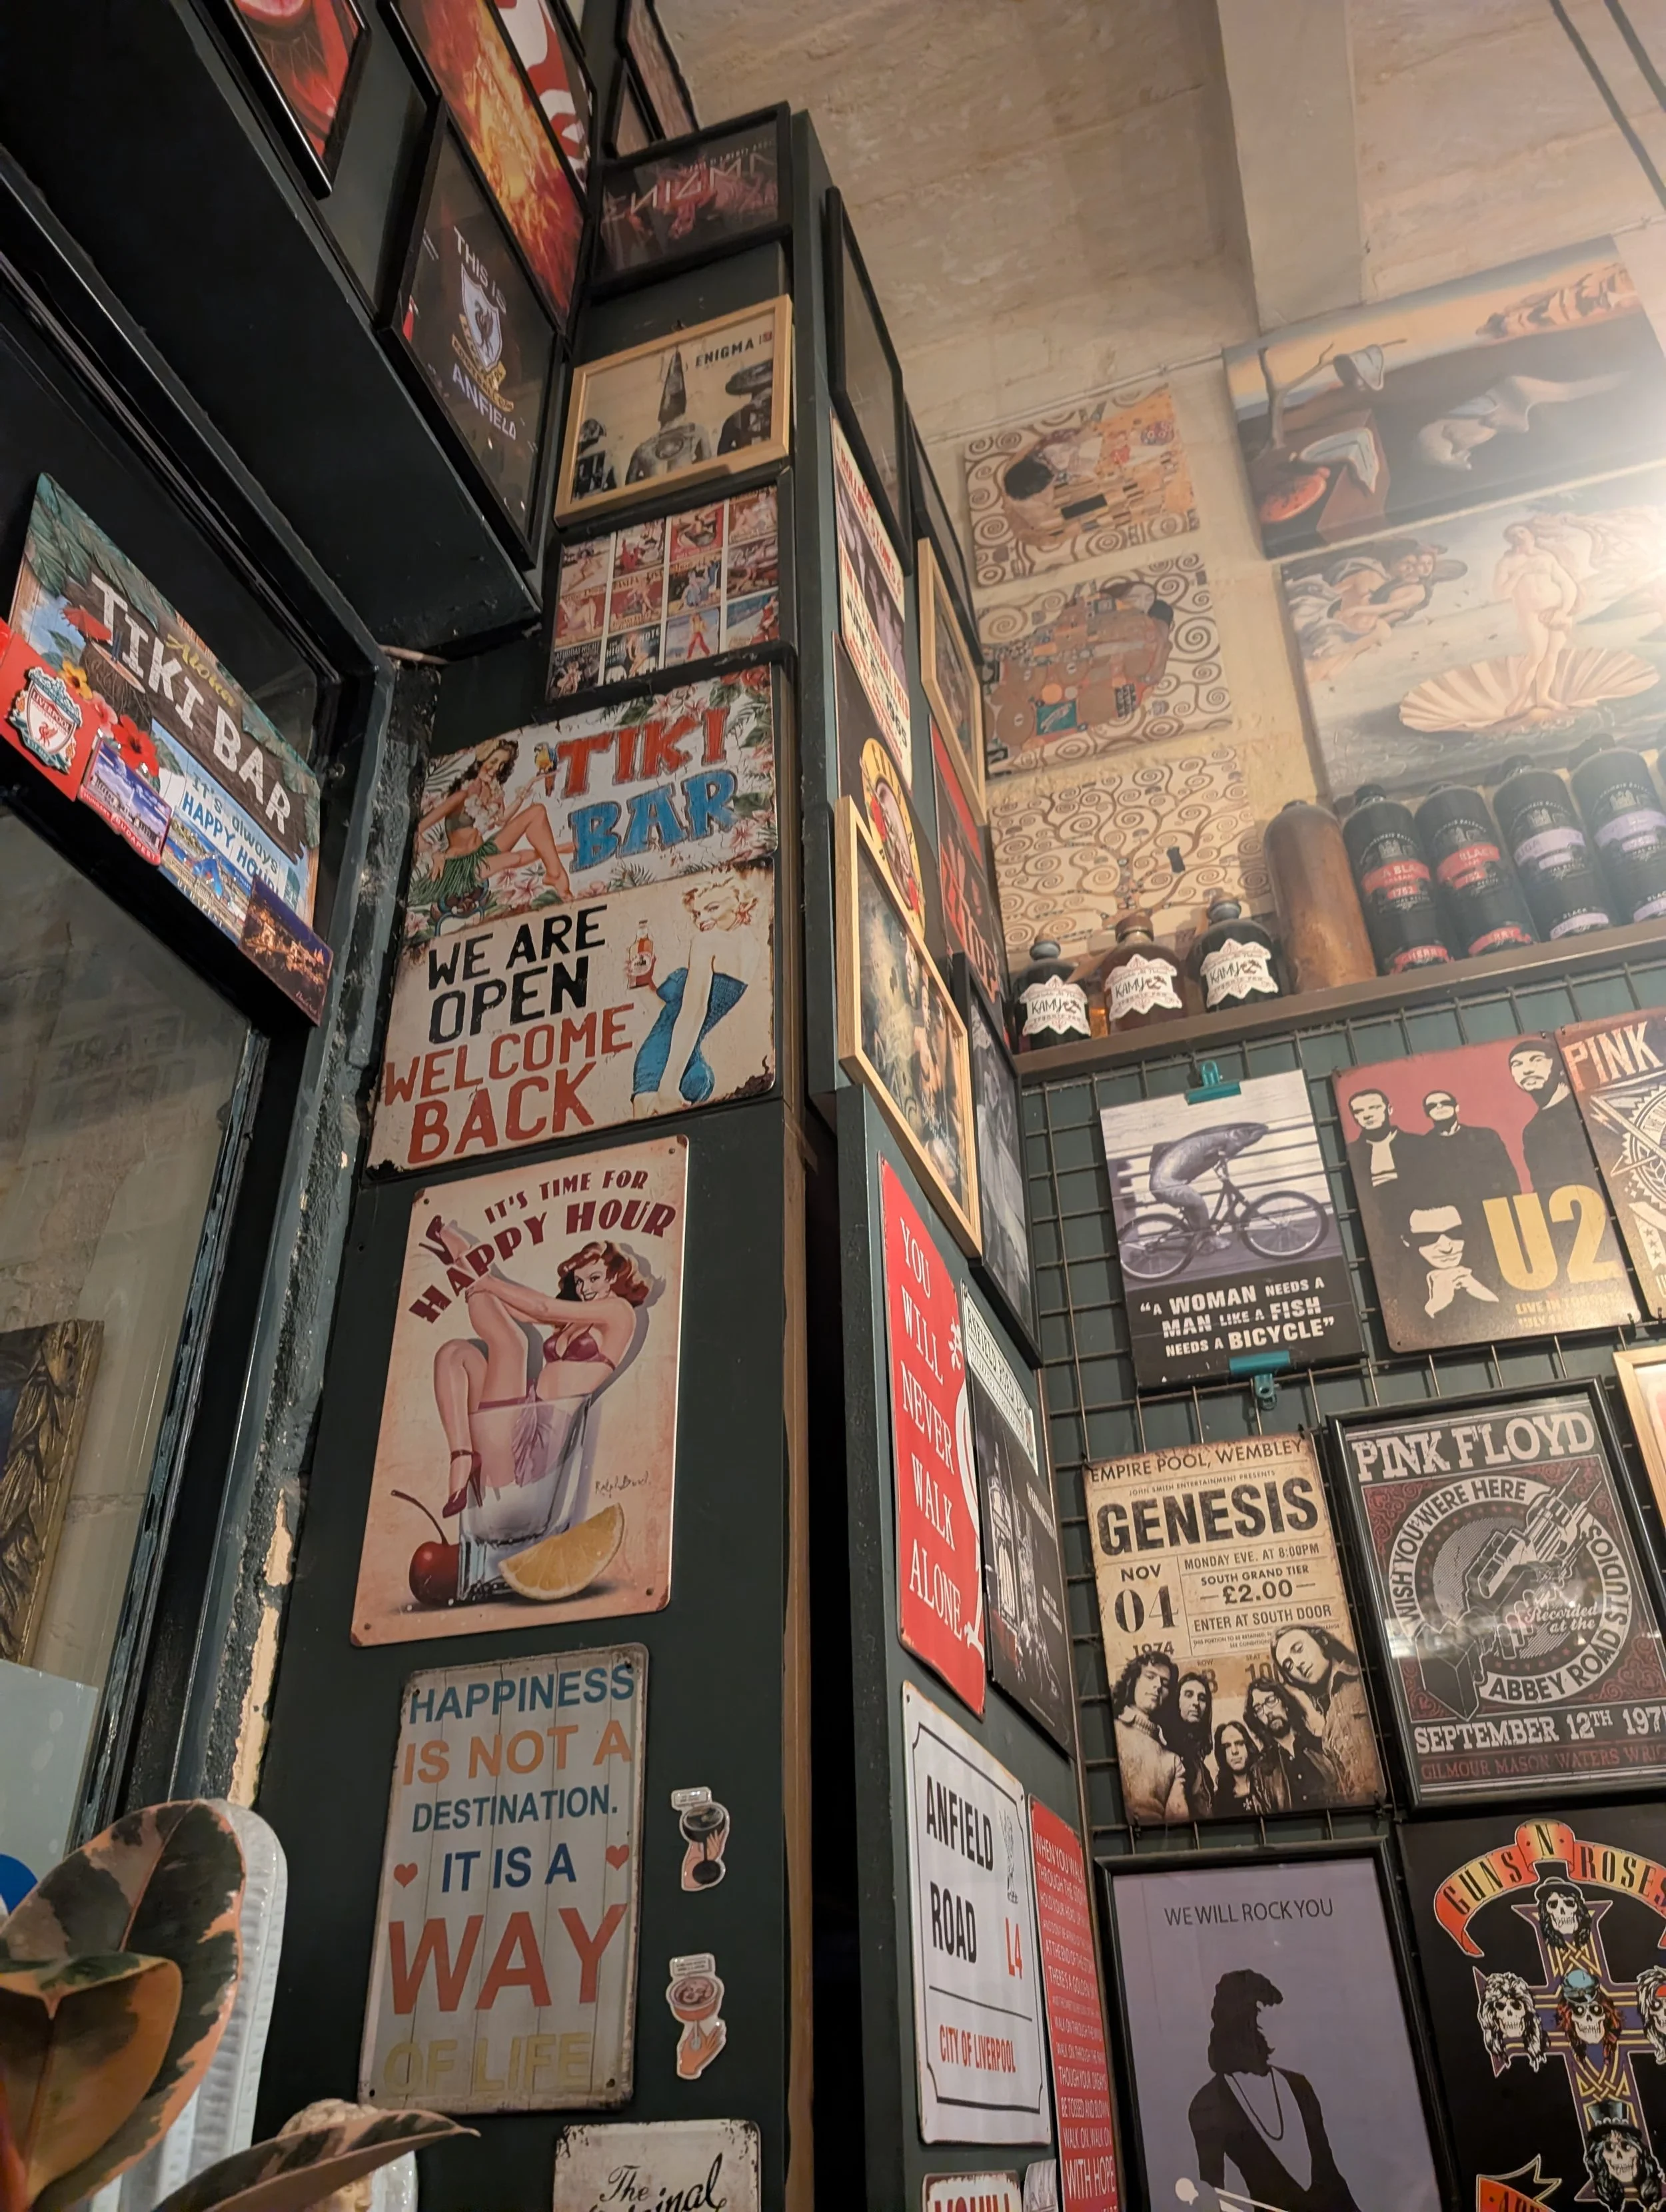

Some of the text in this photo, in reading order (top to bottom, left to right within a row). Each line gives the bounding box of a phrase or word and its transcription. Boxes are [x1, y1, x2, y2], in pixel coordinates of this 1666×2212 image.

[454, 225, 488, 288] THIS
[695, 338, 755, 367] ENIGMA
[452, 363, 517, 440] ANFIELD
[33, 692, 73, 731] LIVERPOOL
[91, 574, 291, 835] TIKI BAR
[885, 692, 908, 748] 1965
[556, 707, 731, 800] TIKI
[182, 791, 236, 849] HAPPY
[231, 814, 279, 875] always
[569, 770, 739, 873] BAR
[428, 903, 608, 991] WE ARE
[429, 956, 589, 1045] OPEN
[385, 1003, 635, 1107] WELCOME
[1561, 1021, 1665, 1093] PINK
[407, 1061, 597, 1165] BACK
[484, 1170, 649, 1224] IT'S TIME FOR
[409, 1199, 677, 1324] HAPPY HOUR
[900, 1216, 932, 1301] YOU
[1482, 1184, 1623, 1291] U2
[1162, 1296, 1322, 1339] MAN LIKE A FISH
[1169, 1285, 1257, 1316] WOMAN
[1265, 1279, 1309, 1297] NEEDS
[1314, 1276, 1325, 1290] A
[901, 1283, 944, 1386] WILL
[967, 1305, 997, 1373] ANFIELD
[1166, 1339, 1210, 1358] NEEDS
[1214, 1337, 1225, 1350] A
[901, 1359, 956, 1476] NEVER
[1351, 1410, 1595, 1482] PINK FLOYD
[1092, 1439, 1302, 1483] EMPIRE POOL, WEMBLEY
[1129, 1469, 1276, 1497] JOHN SMITH ENTERTAINMENT PRESENTS
[910, 1450, 956, 1553] WALK
[1096, 1476, 1319, 1556] GENESIS
[1121, 1564, 1162, 1583] NOV
[1184, 1542, 1320, 1570] MONDAY EVE. AT 8:00PM
[1201, 1564, 1310, 1586] SOUTH GRAND TIER
[1391, 1478, 1527, 1622] WISH YOU WERE HERE
[909, 1536, 963, 1642] ALONE
[1114, 1584, 1180, 1634] 04
[1194, 1604, 1333, 1632] ENTER AT SOUTH DOOR
[1488, 1524, 1629, 1702] ABBEY ROAD STUDIOS
[1523, 1602, 1599, 1623] Recorded
[1549, 1616, 1596, 1633] at the
[409, 1664, 636, 1726] HAPPINESS
[403, 1720, 633, 1786] IS NOT A
[1413, 1705, 1666, 1755] SEPTEMBER 12TH 197
[1421, 1760, 1491, 1782] GILMOUR
[1495, 1754, 1550, 1775] MASON
[1555, 1748, 1620, 1769] WATERS
[412, 1783, 618, 1834] DESTINATION.
[926, 1774, 994, 1873] ANFIELD
[442, 1842, 578, 1894] IT IS A
[1034, 1831, 1084, 1884] WHEN YOU WALK
[1037, 1861, 1064, 1894] THROUGH
[1443, 1850, 1523, 1916] GUNS
[930, 1880, 978, 1964] ROAD
[1164, 1898, 1334, 1927] WE WILL ROCK YOU
[388, 1903, 628, 2016] WAY
[1005, 1915, 1024, 1981] L4
[383, 2030, 593, 2096] OF LIFE
[939, 2023, 1017, 2075] CITY OF LIVERPOOL
[1058, 2065, 1080, 2087] THOUGH
[1061, 2096, 1068, 2118] BE
[1068, 2097, 1084, 2119] TOSSED
[1084, 2099, 1094, 2120] AND
[1063, 2126, 1080, 2149] WALK
[1091, 2127, 1105, 2149] WALK
[600, 2163, 650, 2203] The
[1066, 2155, 1116, 2201] WITH HOPE
